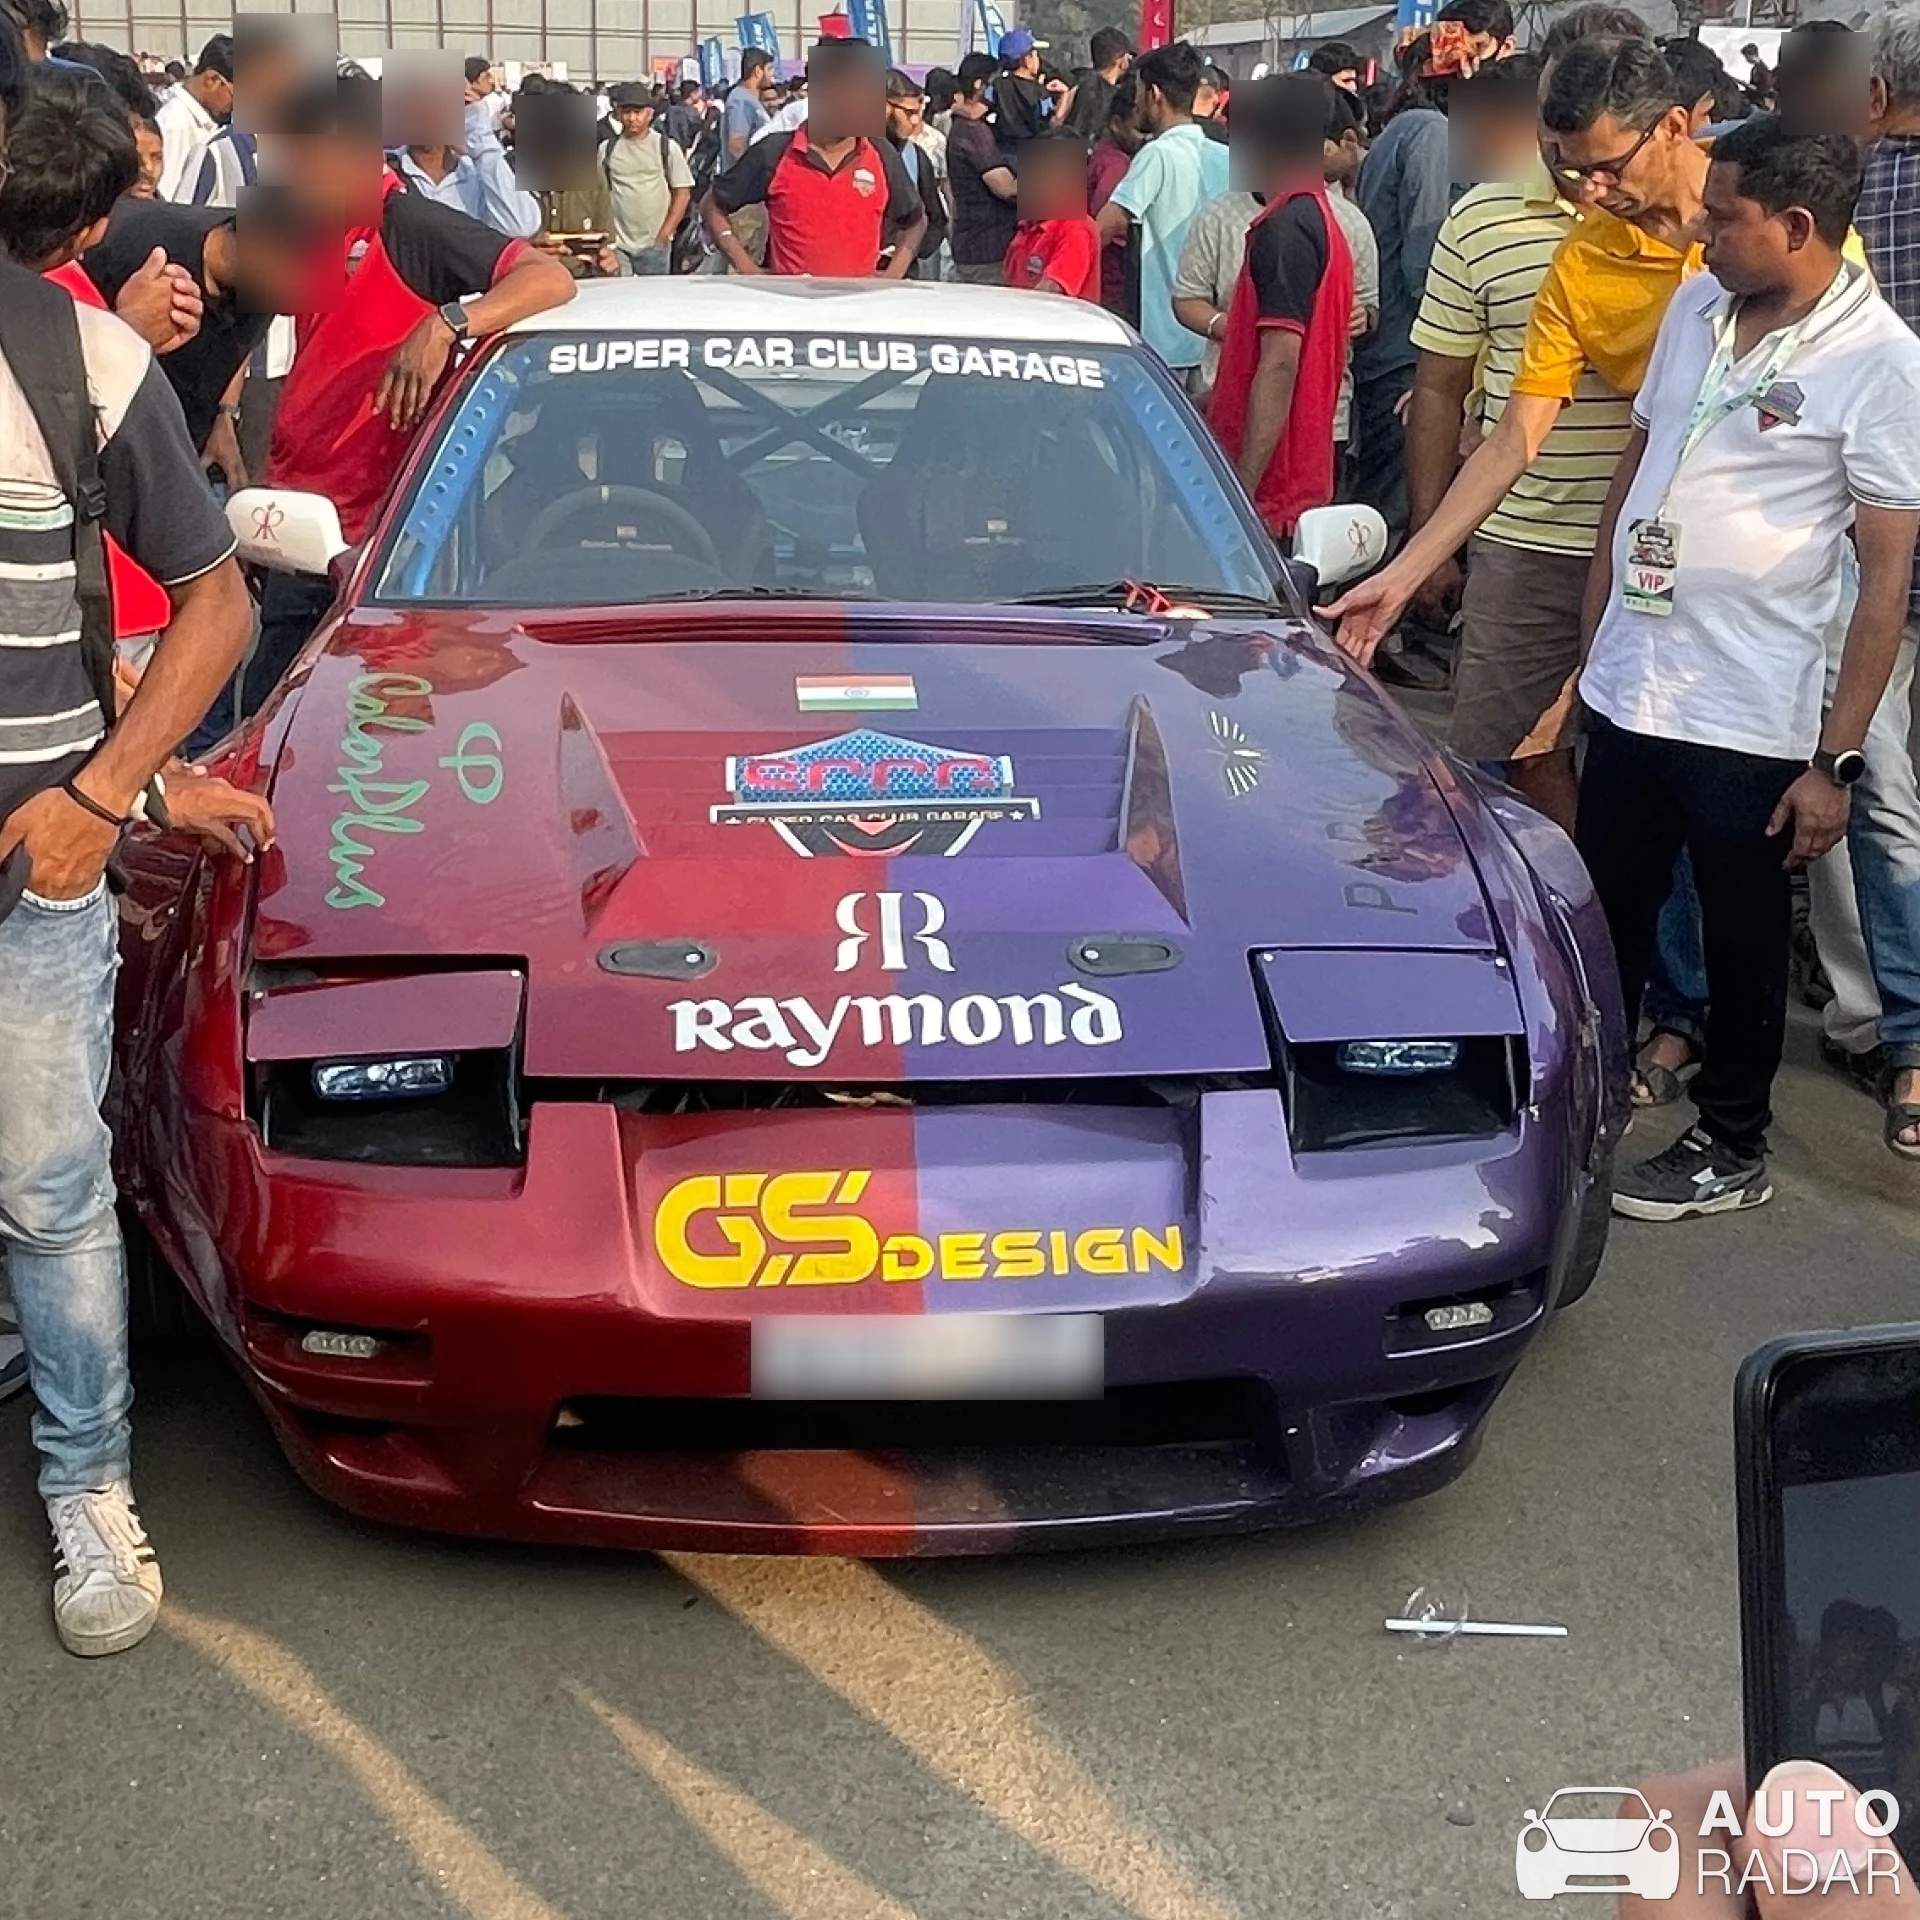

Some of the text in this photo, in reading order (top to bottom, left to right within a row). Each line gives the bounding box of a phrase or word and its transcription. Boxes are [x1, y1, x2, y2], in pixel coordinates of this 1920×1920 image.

[547, 337, 1105, 389] SUPER CAR CLUB GARAGE
[1637, 571, 1666, 591] VIP
